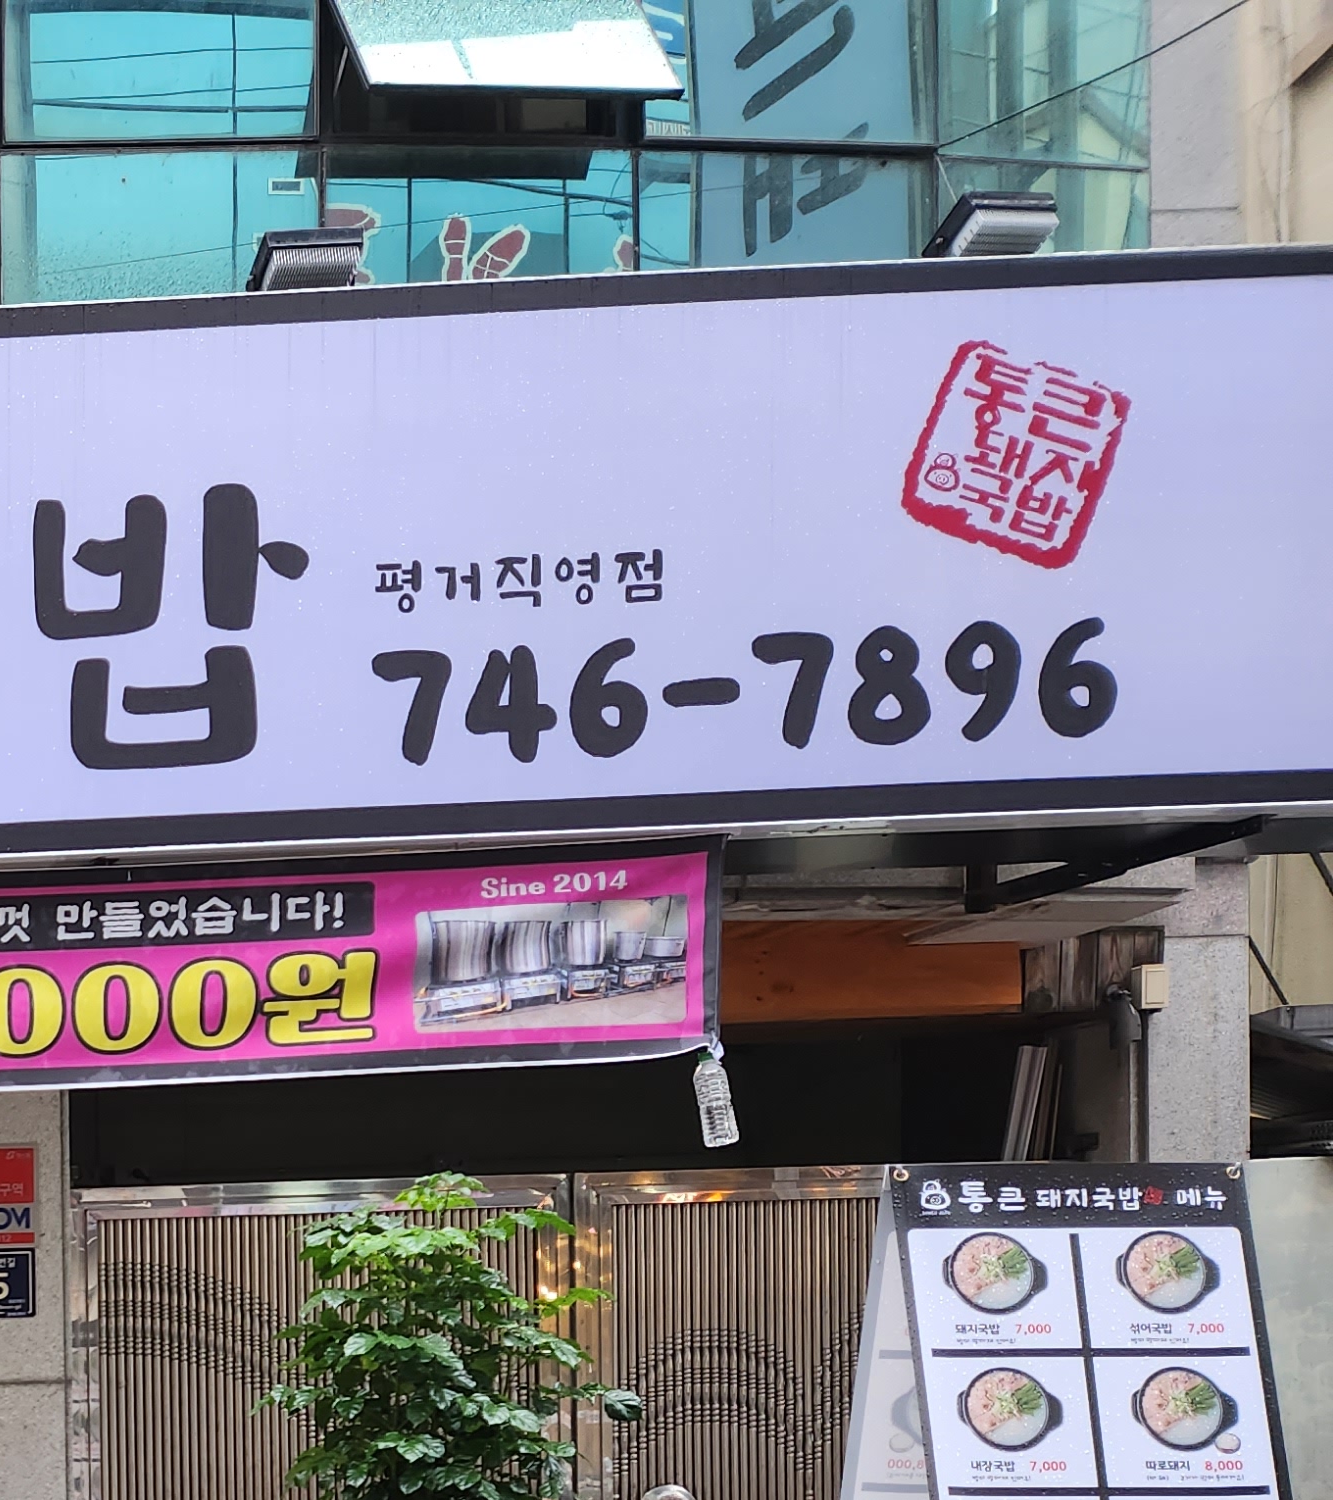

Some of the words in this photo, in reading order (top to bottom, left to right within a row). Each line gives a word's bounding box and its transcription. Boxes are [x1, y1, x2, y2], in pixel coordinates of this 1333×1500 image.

[963, 353, 1107, 454] 통큰
[374, 549, 665, 613] 평거직영점
[371, 617, 1117, 765] 746-7896
[480, 877, 545, 898] Sine
[553, 870, 628, 895] 2014
[55, 890, 346, 942] 만들었습니다!
[958, 1180, 1026, 1213] 통큰
[1035, 1186, 1143, 1211] 돼지국밥
[1176, 1186, 1227, 1210] 메뉴
[955, 1324, 1000, 1335] 돼지국밥
[1015, 1324, 1051, 1335] 7,000
